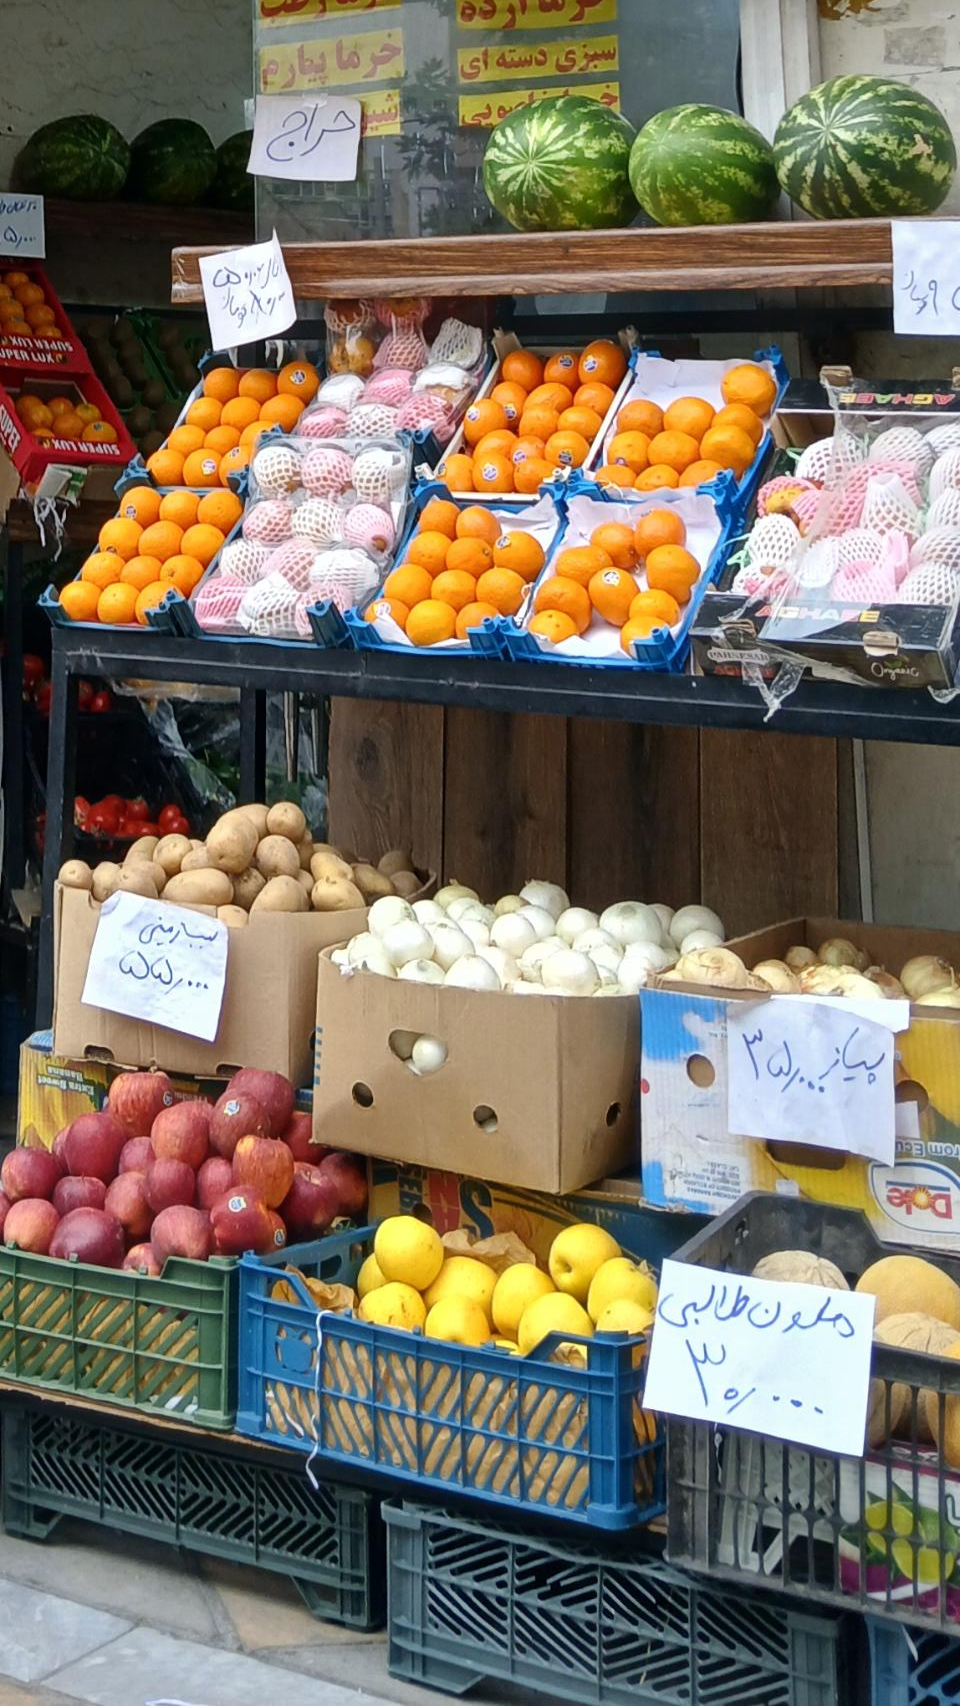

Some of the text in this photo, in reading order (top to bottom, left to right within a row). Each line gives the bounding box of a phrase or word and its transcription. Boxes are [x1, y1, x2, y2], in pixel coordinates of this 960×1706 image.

[262, 31, 402, 90] خرما پیارم
[460, 44, 617, 79] سبزی دسته ای
[266, 102, 357, 163] حراج
[8, 335, 73, 352] SUPER LUX
[30, 351, 55, 364] LUX
[52, 438, 121, 455] SUPER LUX
[871, 661, 920, 679] Organic
[821, 1027, 886, 1085] پیاز
[47, 1065, 84, 1082] Banana
[66, 1080, 95, 1095] Extra
[930, 1141, 960, 1157] rom
[886, 1187, 953, 1220] Dole
[658, 1283, 750, 1329] طالبی
